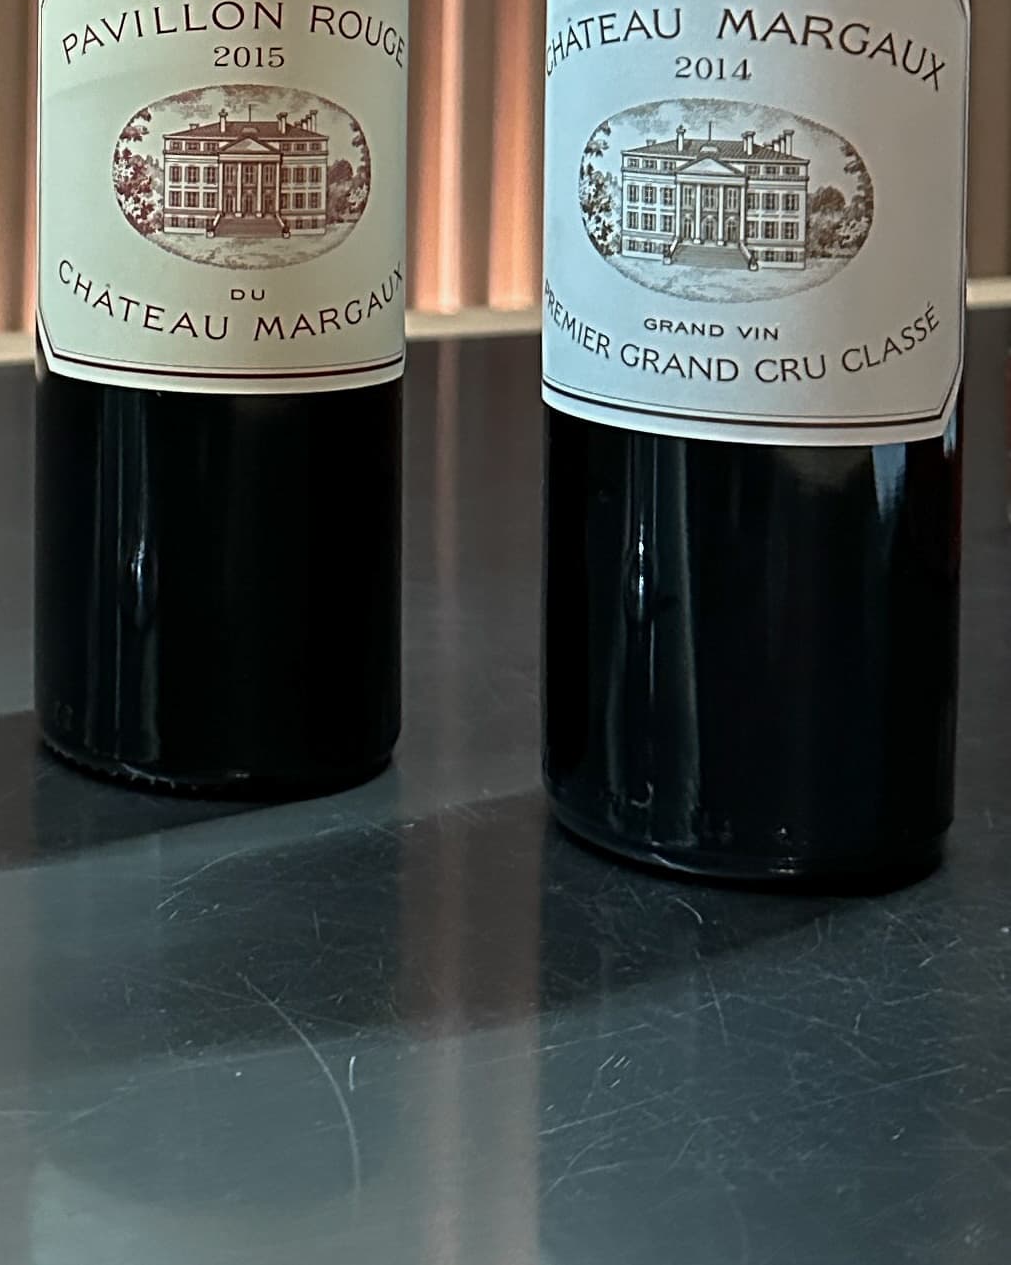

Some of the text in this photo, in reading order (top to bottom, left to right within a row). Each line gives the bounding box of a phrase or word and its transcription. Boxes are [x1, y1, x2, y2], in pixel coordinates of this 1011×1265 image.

[61, 0, 405, 68] PAVILLON ROUGE
[213, 45, 286, 68] 2015
[546, 7, 947, 93] CHÂTEAU MARGAUX
[674, 55, 753, 82] 2014
[58, 259, 403, 342] CHÂTEAU MARGAUX
[230, 288, 266, 302] DU
[544, 278, 941, 385] PREMIER GRAND CRU CLASSÉ
[643, 316, 779, 341] GRAND VIN
